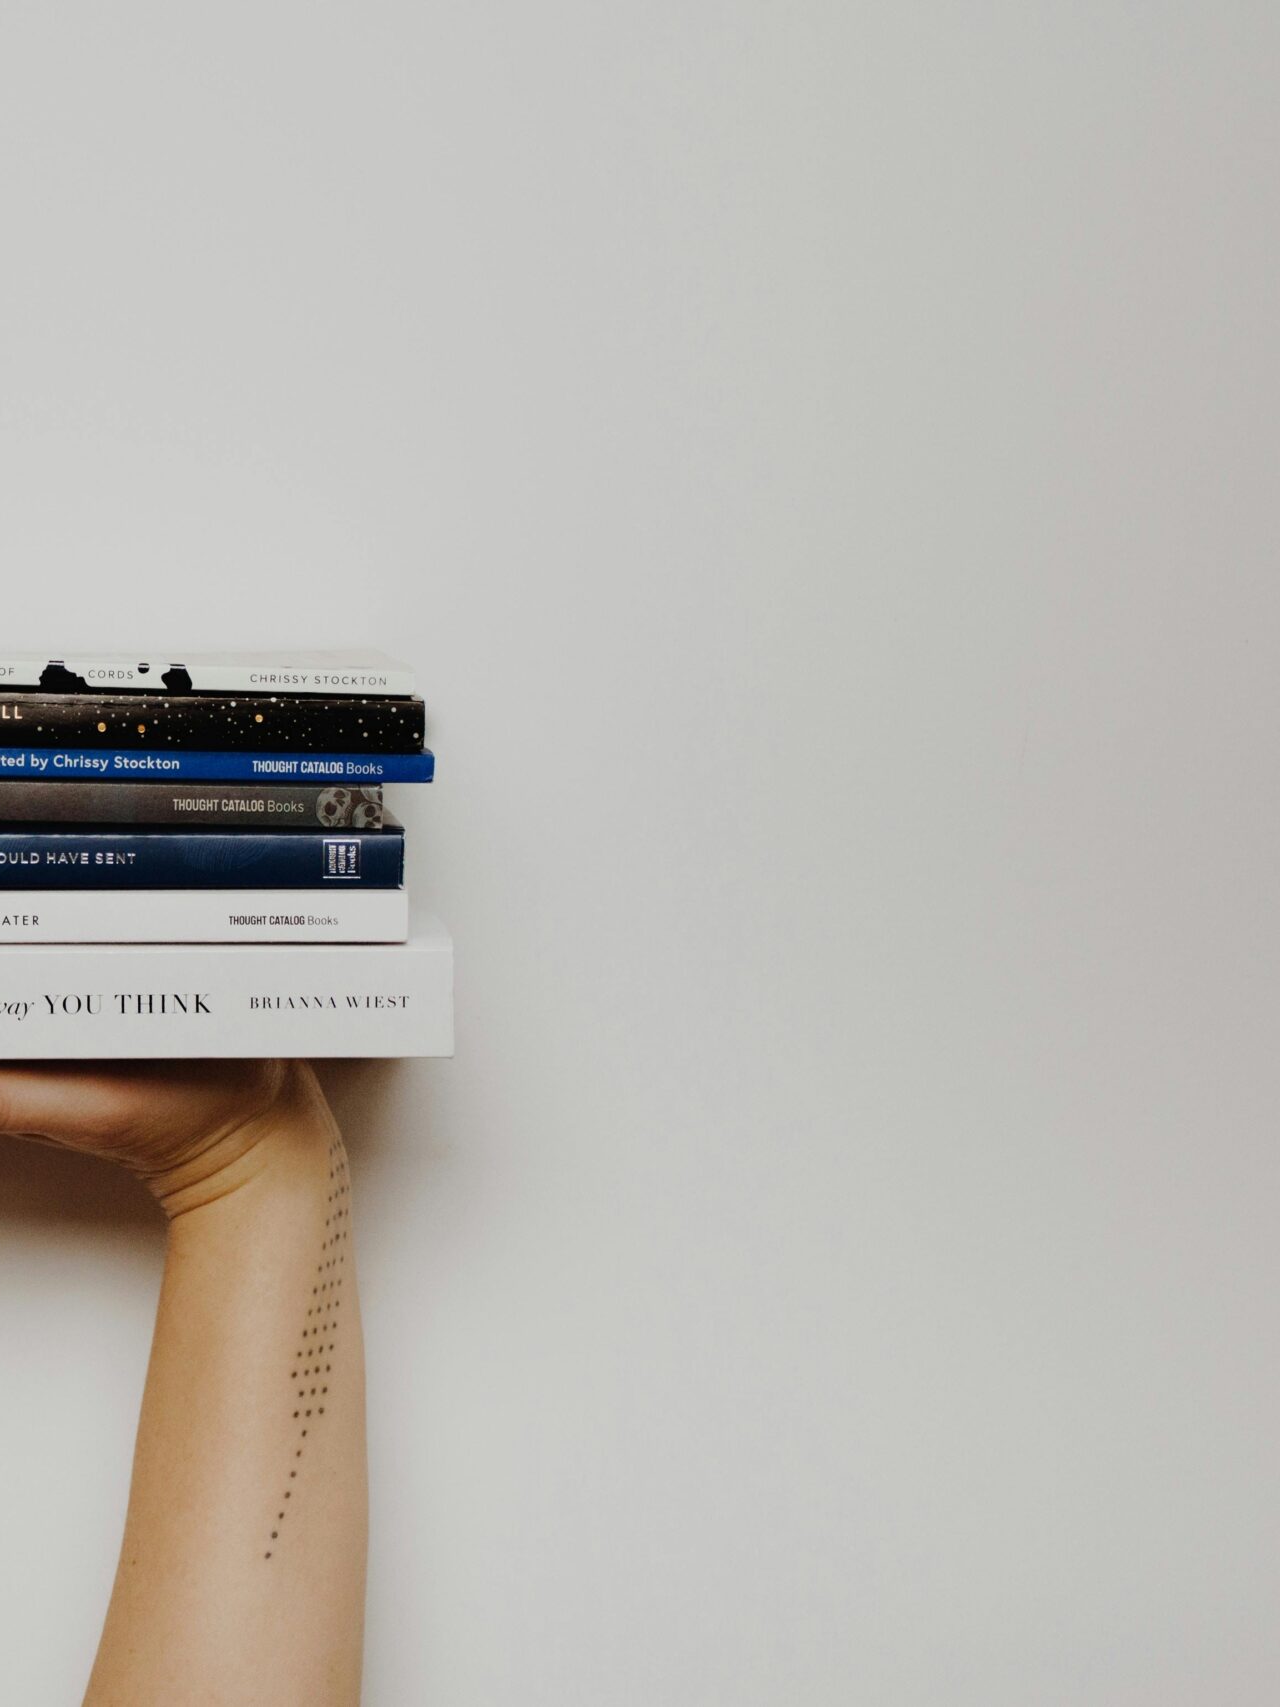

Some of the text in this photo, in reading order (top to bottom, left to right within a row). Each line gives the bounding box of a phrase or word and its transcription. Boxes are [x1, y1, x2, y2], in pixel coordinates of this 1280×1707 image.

[88, 669, 134, 680] CORDS
[249, 673, 388, 686] CHRISSY STOCKTON
[30, 754, 49, 771] by
[53, 755, 109, 771] Chrissy
[114, 756, 180, 770] Stockton
[252, 760, 383, 775] THOUGHT CATALOG Books
[173, 799, 304, 813] THOUGHT CATALOG Books
[46, 853, 89, 864] HAVE
[95, 853, 136, 864] SENT
[228, 915, 339, 926] THOUGHT CATALOG Books
[44, 995, 101, 1015] YOU
[114, 994, 211, 1014] THINK
[249, 996, 410, 1010] BRIANNA WIEST
